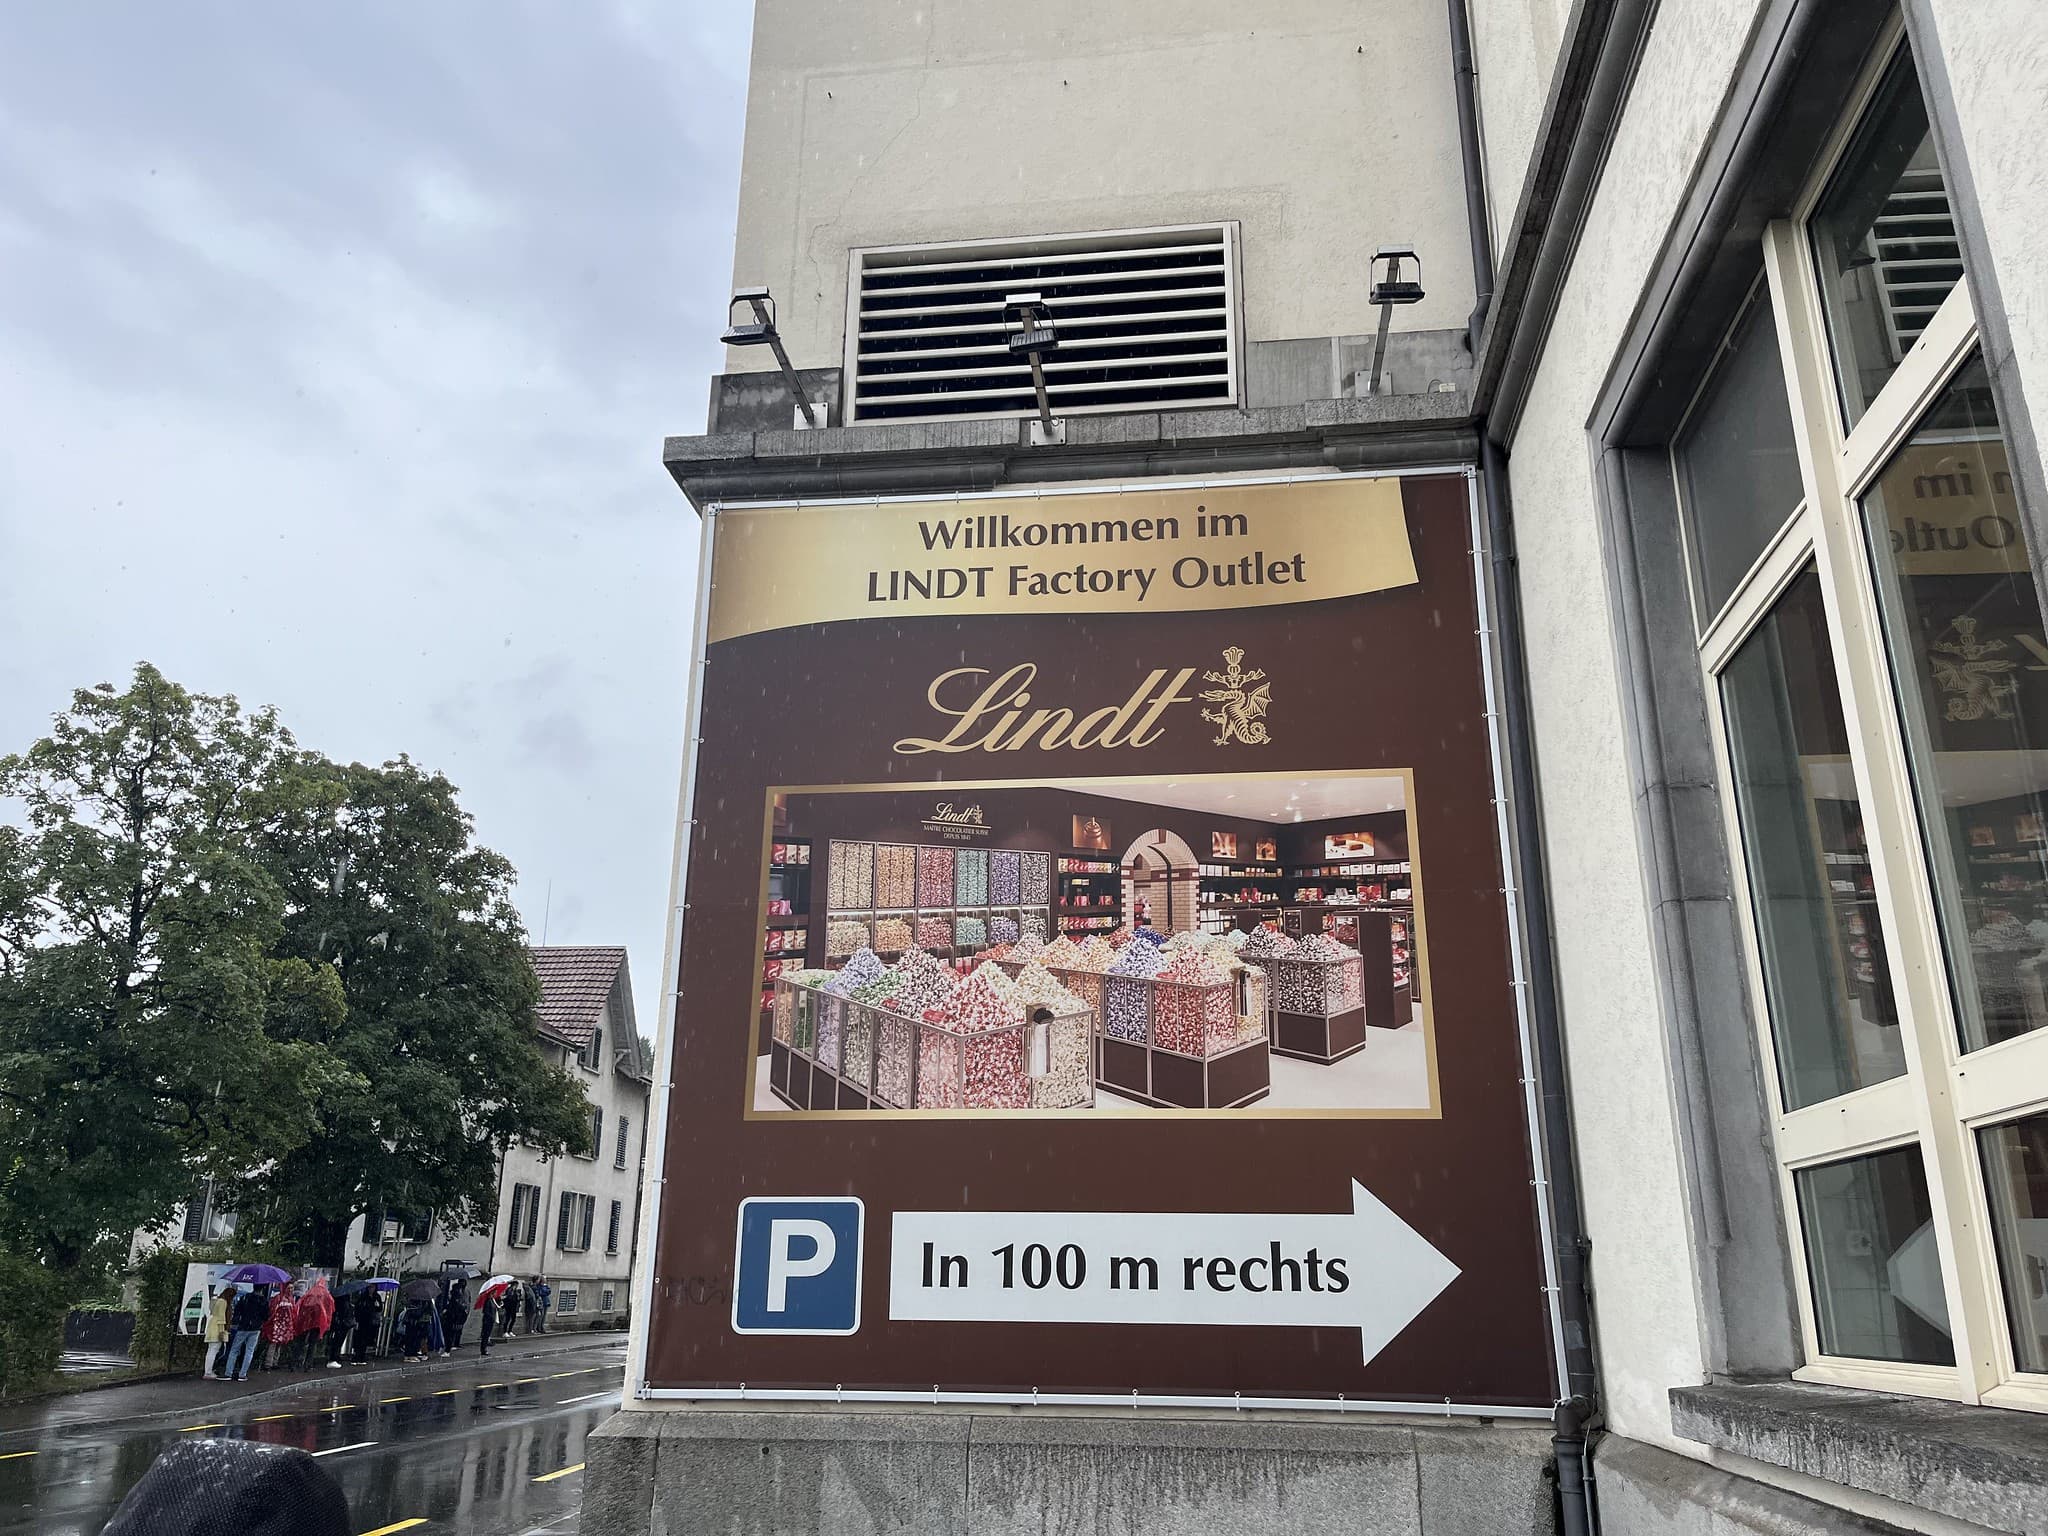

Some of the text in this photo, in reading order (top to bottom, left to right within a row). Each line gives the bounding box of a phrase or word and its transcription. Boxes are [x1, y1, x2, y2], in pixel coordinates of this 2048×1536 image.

[919, 506, 1248, 551] Willkommen im
[868, 551, 1307, 602] LINDT Factory Outlet
[893, 662, 1197, 755] Lindt
[931, 802, 974, 823] Lindt
[766, 1219, 836, 1312] P
[922, 1242, 1350, 1294] In 100 m rechts
